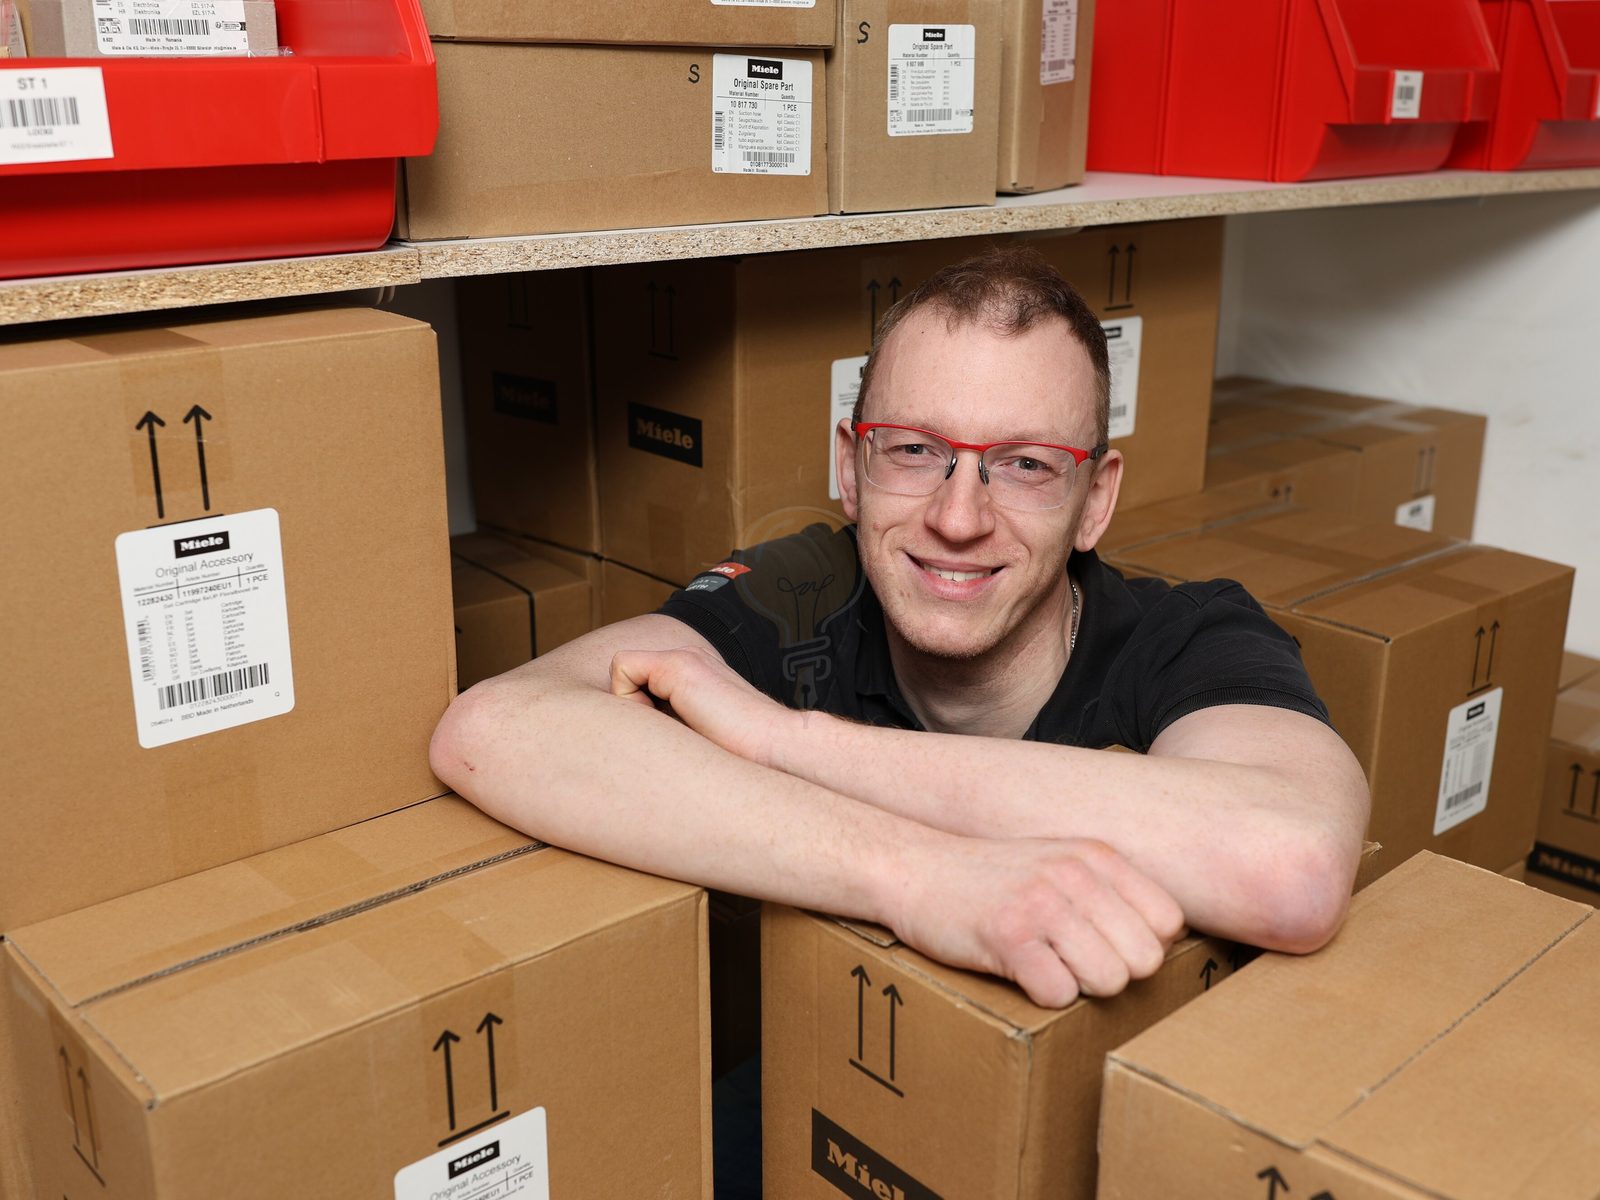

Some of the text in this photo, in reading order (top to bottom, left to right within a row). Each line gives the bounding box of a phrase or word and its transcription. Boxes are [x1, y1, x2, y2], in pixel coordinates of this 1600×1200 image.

[857, 22, 870, 43] S
[688, 64, 700, 83] S
[752, 65, 779, 74] Miele
[17, 77, 35, 90] ST
[734, 78, 793, 90] Original Spare Part
[749, 101, 757, 109] 730
[636, 417, 694, 449] Miele
[180, 536, 224, 552] Miele
[155, 552, 254, 579] Original Accessory
[252, 573, 269, 583] PCE
[196, 707, 212, 718] Made
[453, 1147, 495, 1172] Miele
[430, 1179, 469, 1200] Original
[472, 1155, 521, 1183] Accessory
[520, 1171, 533, 1182] PCE
